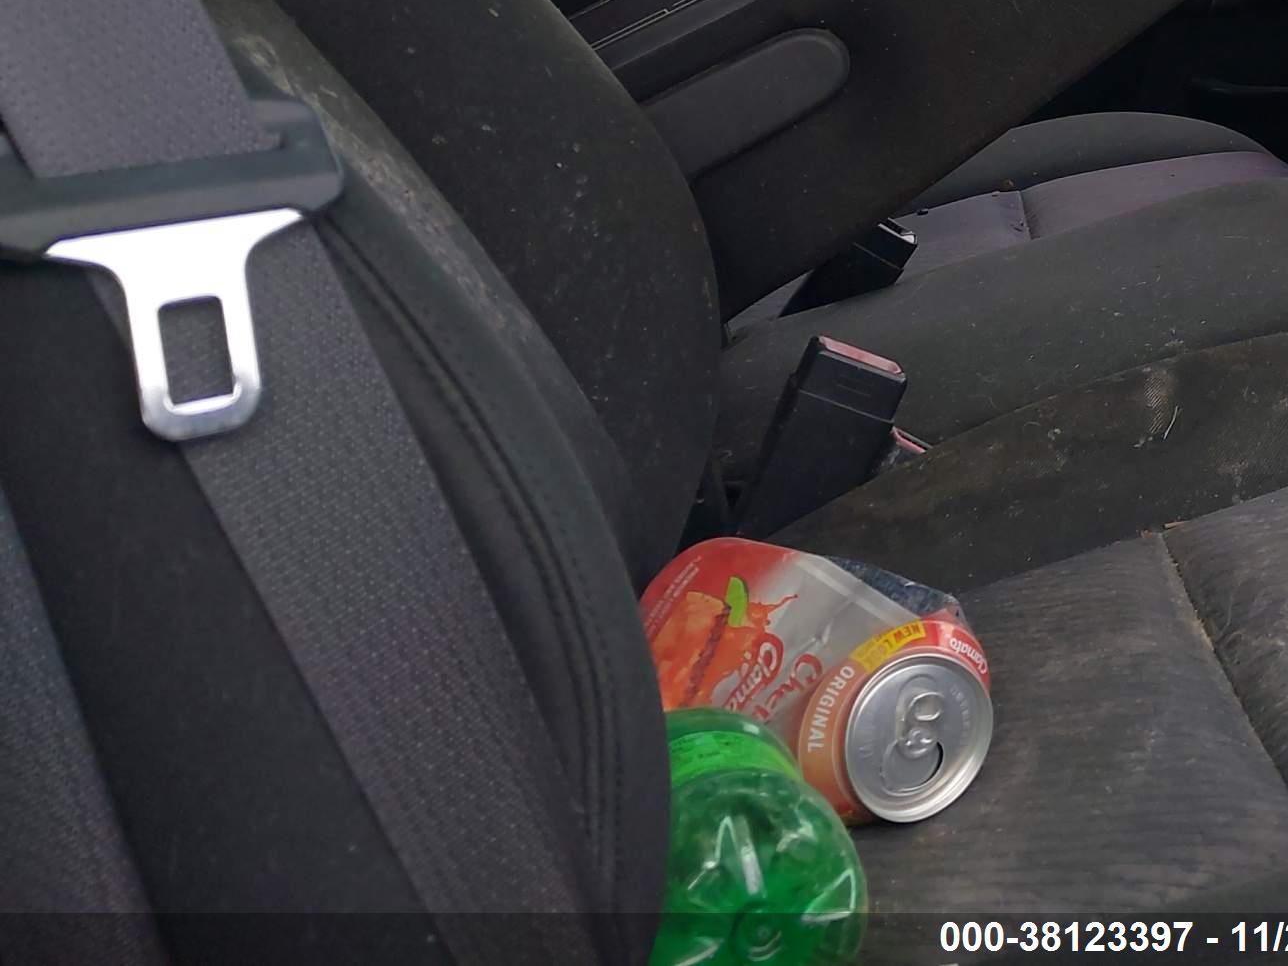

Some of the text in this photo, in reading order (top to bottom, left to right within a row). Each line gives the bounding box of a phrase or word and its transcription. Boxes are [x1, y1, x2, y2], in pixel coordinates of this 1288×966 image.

[893, 624, 920, 641] NEW
[949, 637, 988, 674] Clamato
[807, 665, 855, 752] ORIGINAL
